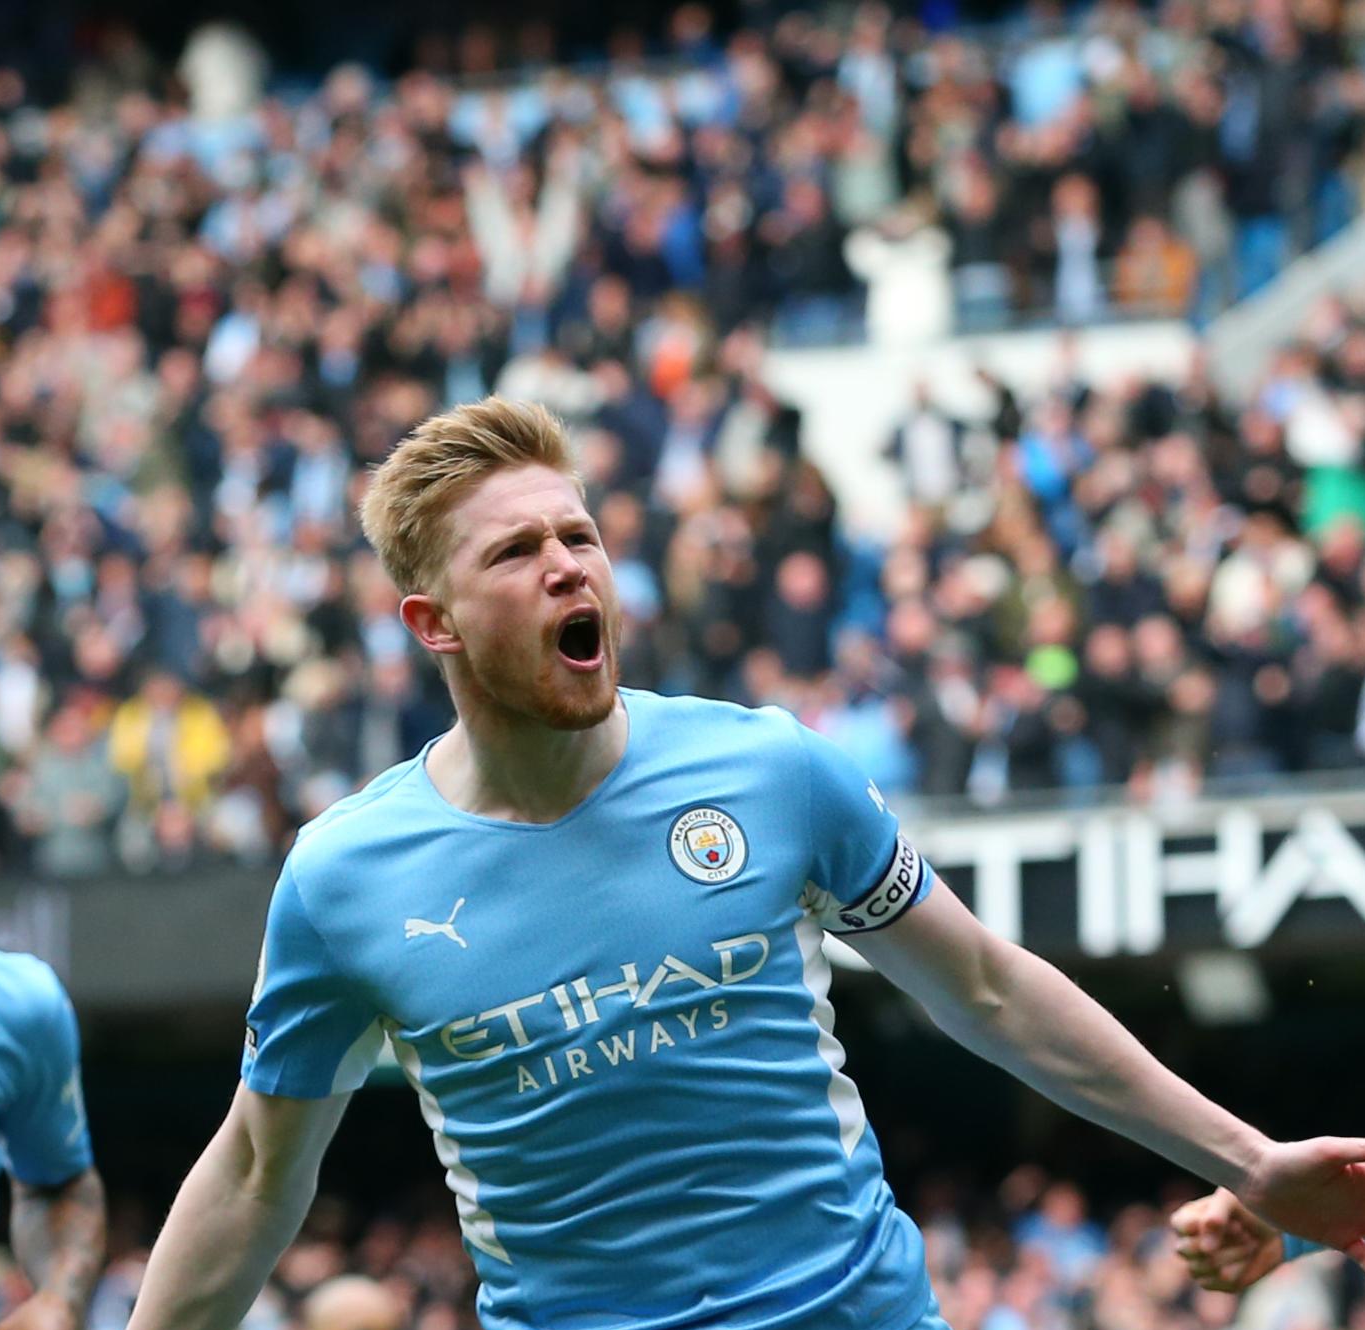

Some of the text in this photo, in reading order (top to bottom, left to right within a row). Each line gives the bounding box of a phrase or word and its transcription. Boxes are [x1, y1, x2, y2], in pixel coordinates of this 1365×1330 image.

[674, 810, 735, 842] MANCHESTER
[707, 868, 730, 880] CITY
[866, 845, 915, 918] Capta
[440, 933, 770, 1061] ETIHAD
[517, 999, 730, 1094] AIRWAYS
